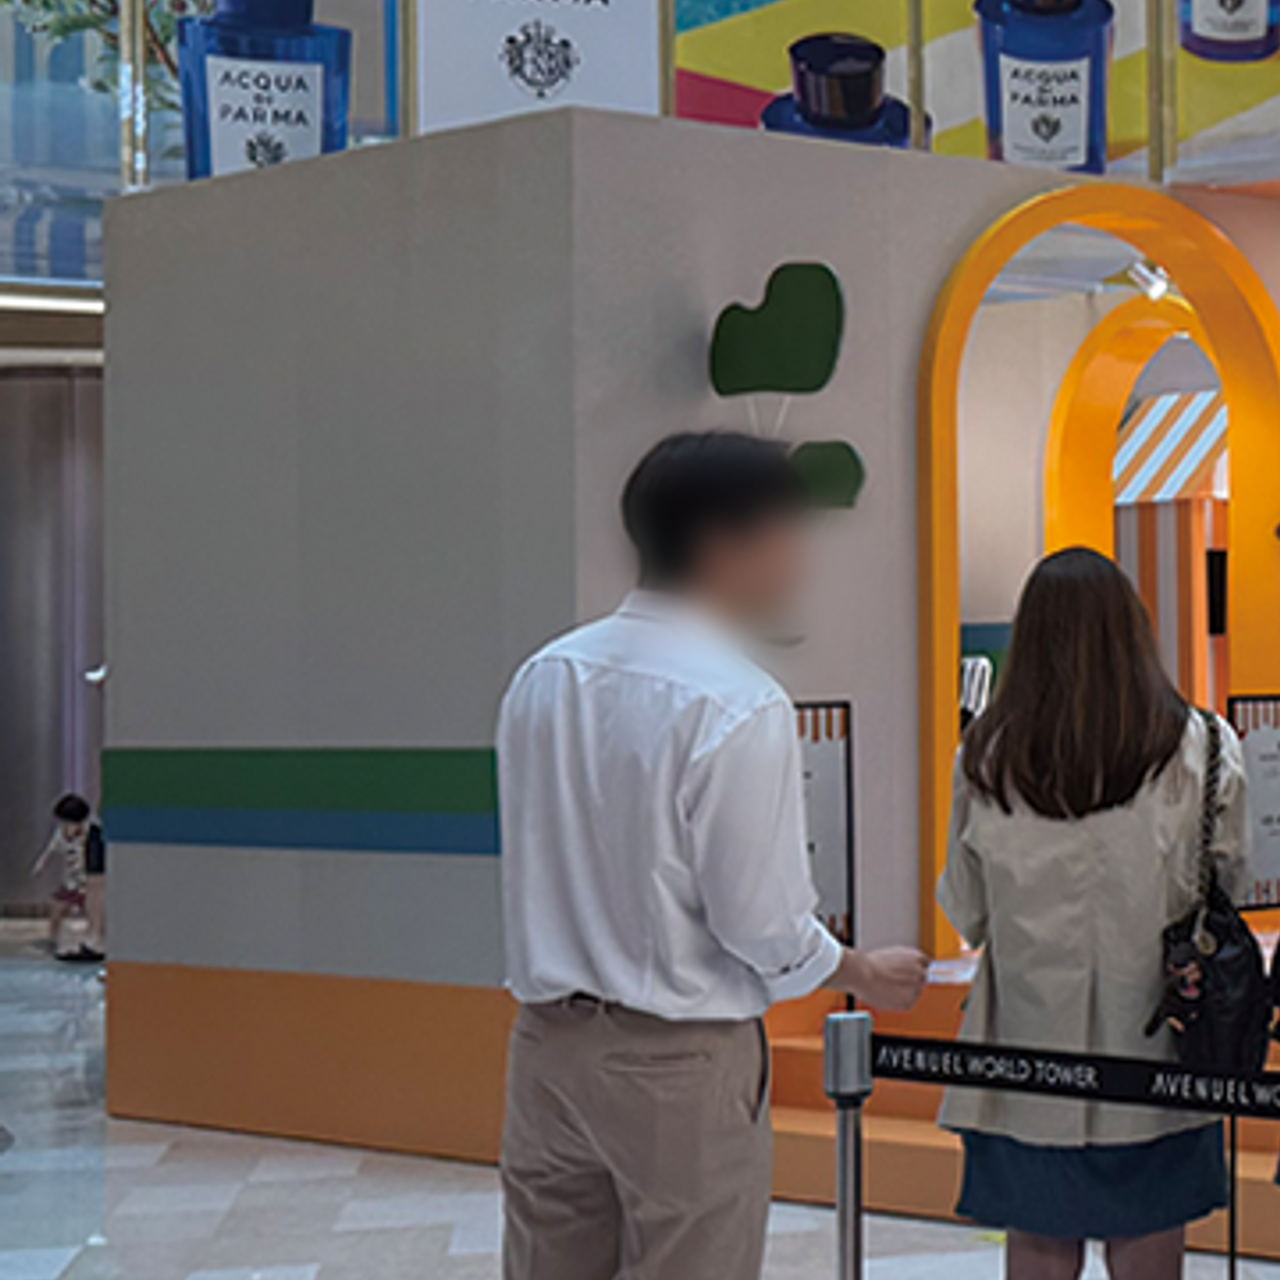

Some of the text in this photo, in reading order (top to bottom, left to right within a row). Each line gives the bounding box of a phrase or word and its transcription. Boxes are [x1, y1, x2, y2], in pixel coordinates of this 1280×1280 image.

[219, 71, 310, 93] ACQUA
[220, 104, 310, 127] PARMA
[877, 1045, 1099, 1089] AVENUEL WORLD TOWER
[1152, 1073, 1249, 1105] AVENUEL
